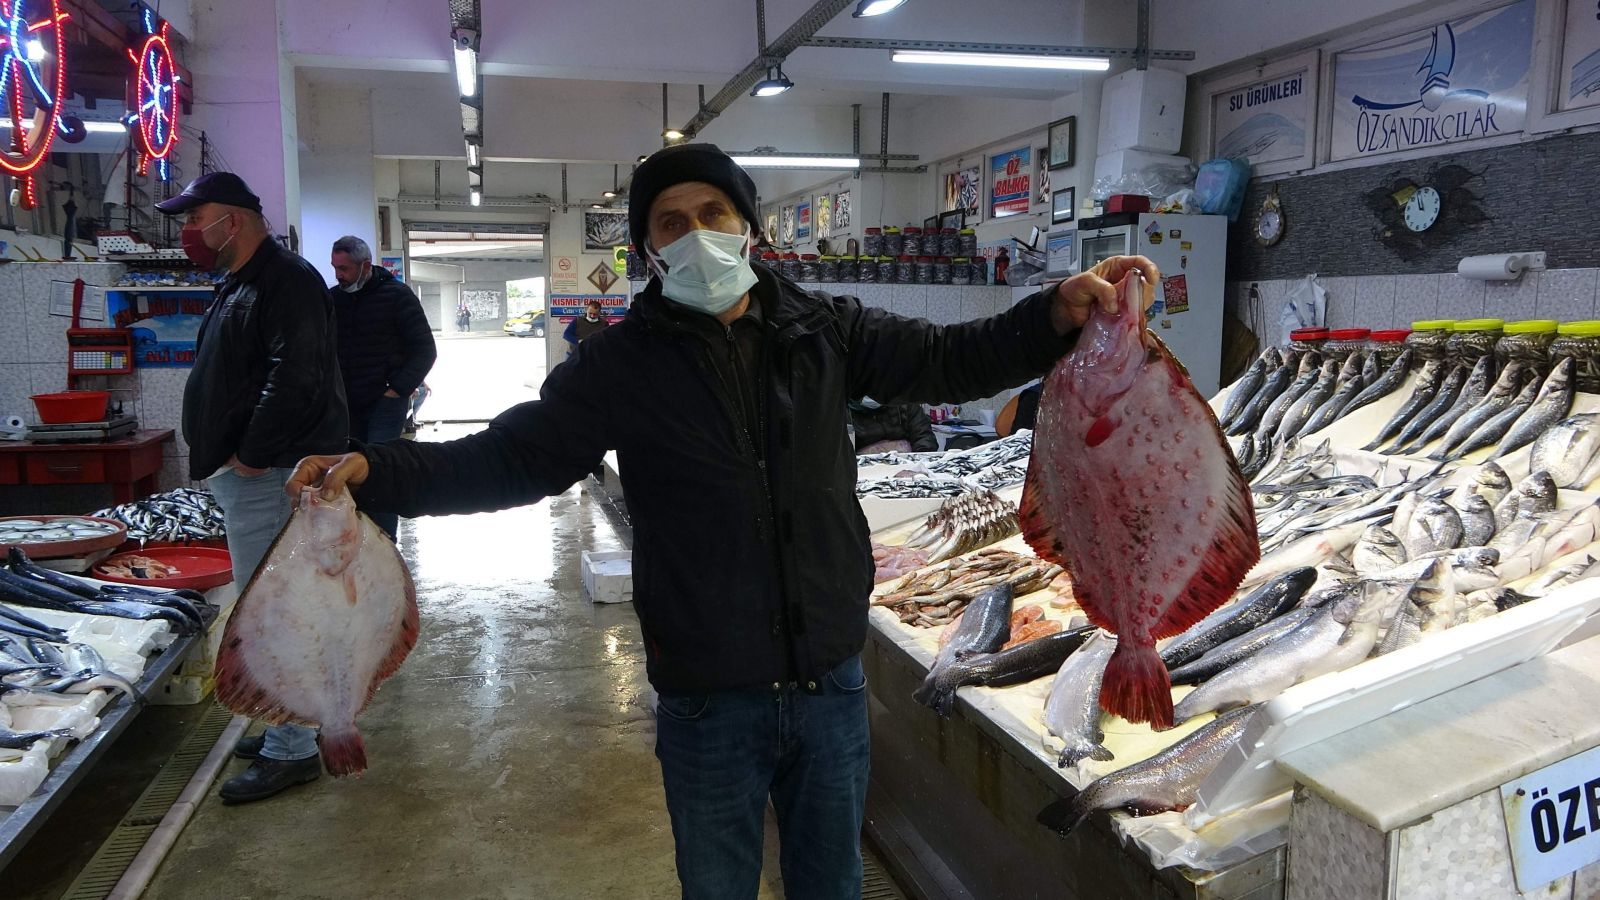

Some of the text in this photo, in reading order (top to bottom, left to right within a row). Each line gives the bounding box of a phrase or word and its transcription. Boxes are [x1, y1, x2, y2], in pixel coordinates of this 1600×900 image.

[1229, 74, 1302, 111] SU ÜRÜNLERİ
[1006, 154, 1021, 176] ÖZ
[552, 298, 582, 306] KISMET
